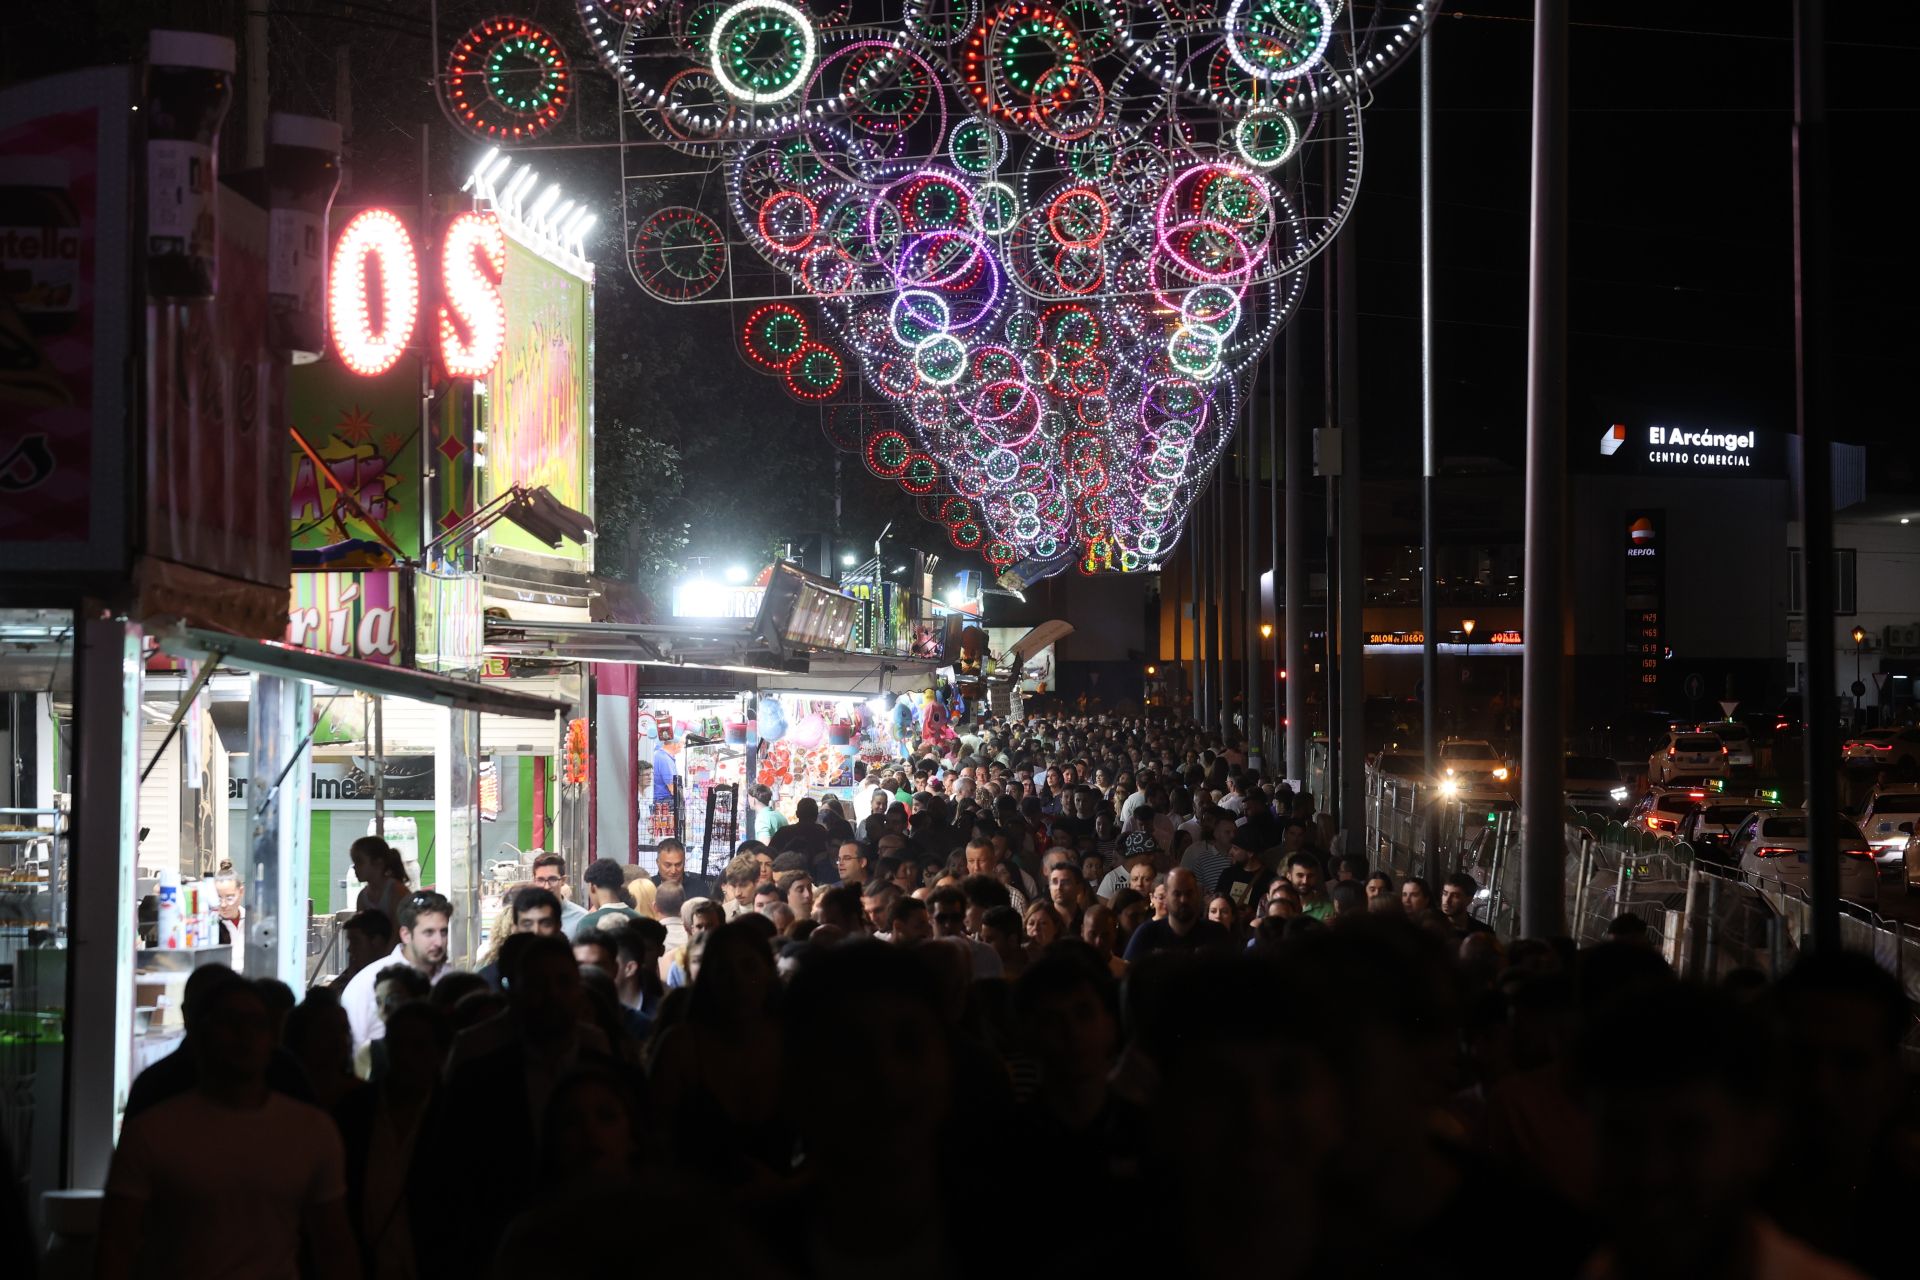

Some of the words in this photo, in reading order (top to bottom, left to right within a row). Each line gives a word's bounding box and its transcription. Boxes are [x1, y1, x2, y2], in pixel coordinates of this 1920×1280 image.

[1649, 426, 1666, 445] El
[1669, 428, 1755, 452] Arcángel
[1649, 451, 1689, 464] CENTRO
[1693, 454, 1751, 467] COMERCIAL
[1627, 548, 1656, 557] REPSOL
[1491, 632, 1522, 643] JOKER
